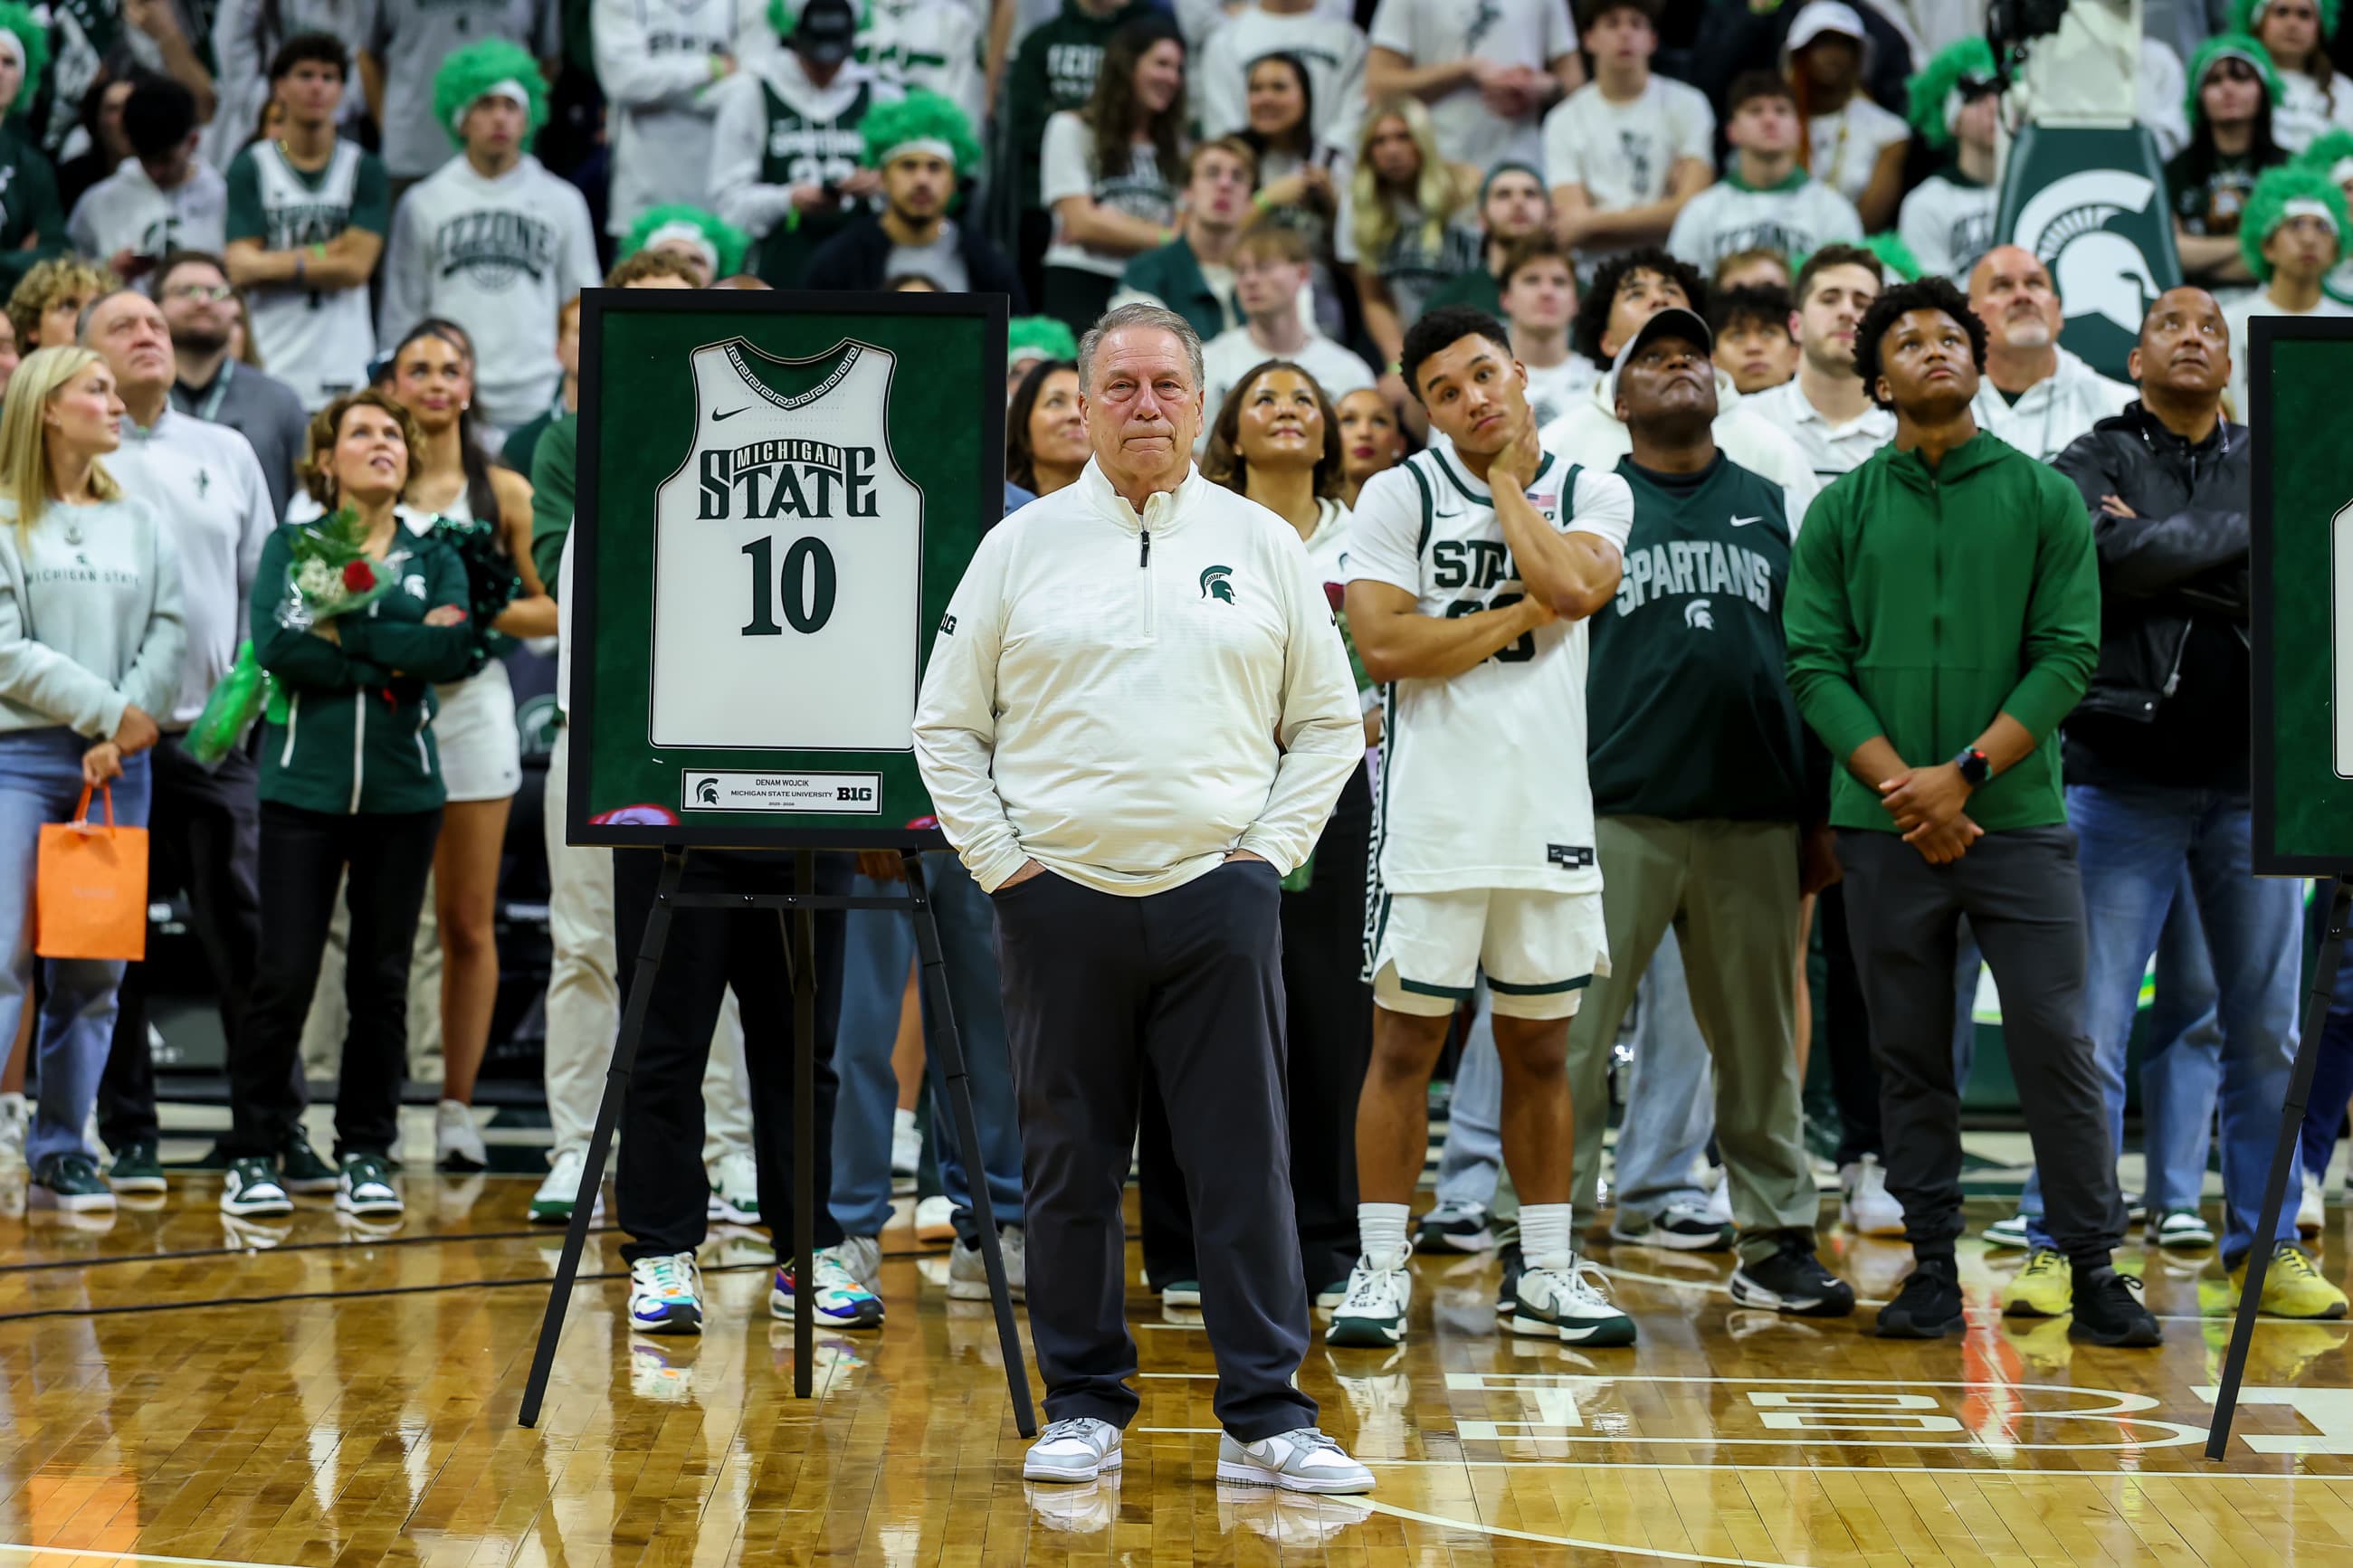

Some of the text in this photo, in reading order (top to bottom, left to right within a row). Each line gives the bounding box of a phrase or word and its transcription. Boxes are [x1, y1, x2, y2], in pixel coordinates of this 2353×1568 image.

[695, 446, 881, 519] STATE
[737, 441, 839, 469] MICHIGAN
[742, 535, 836, 636] 10
[1434, 539, 1522, 588] STA
[1615, 540, 1771, 617] SPARTANS
[939, 613, 957, 637] 1G
